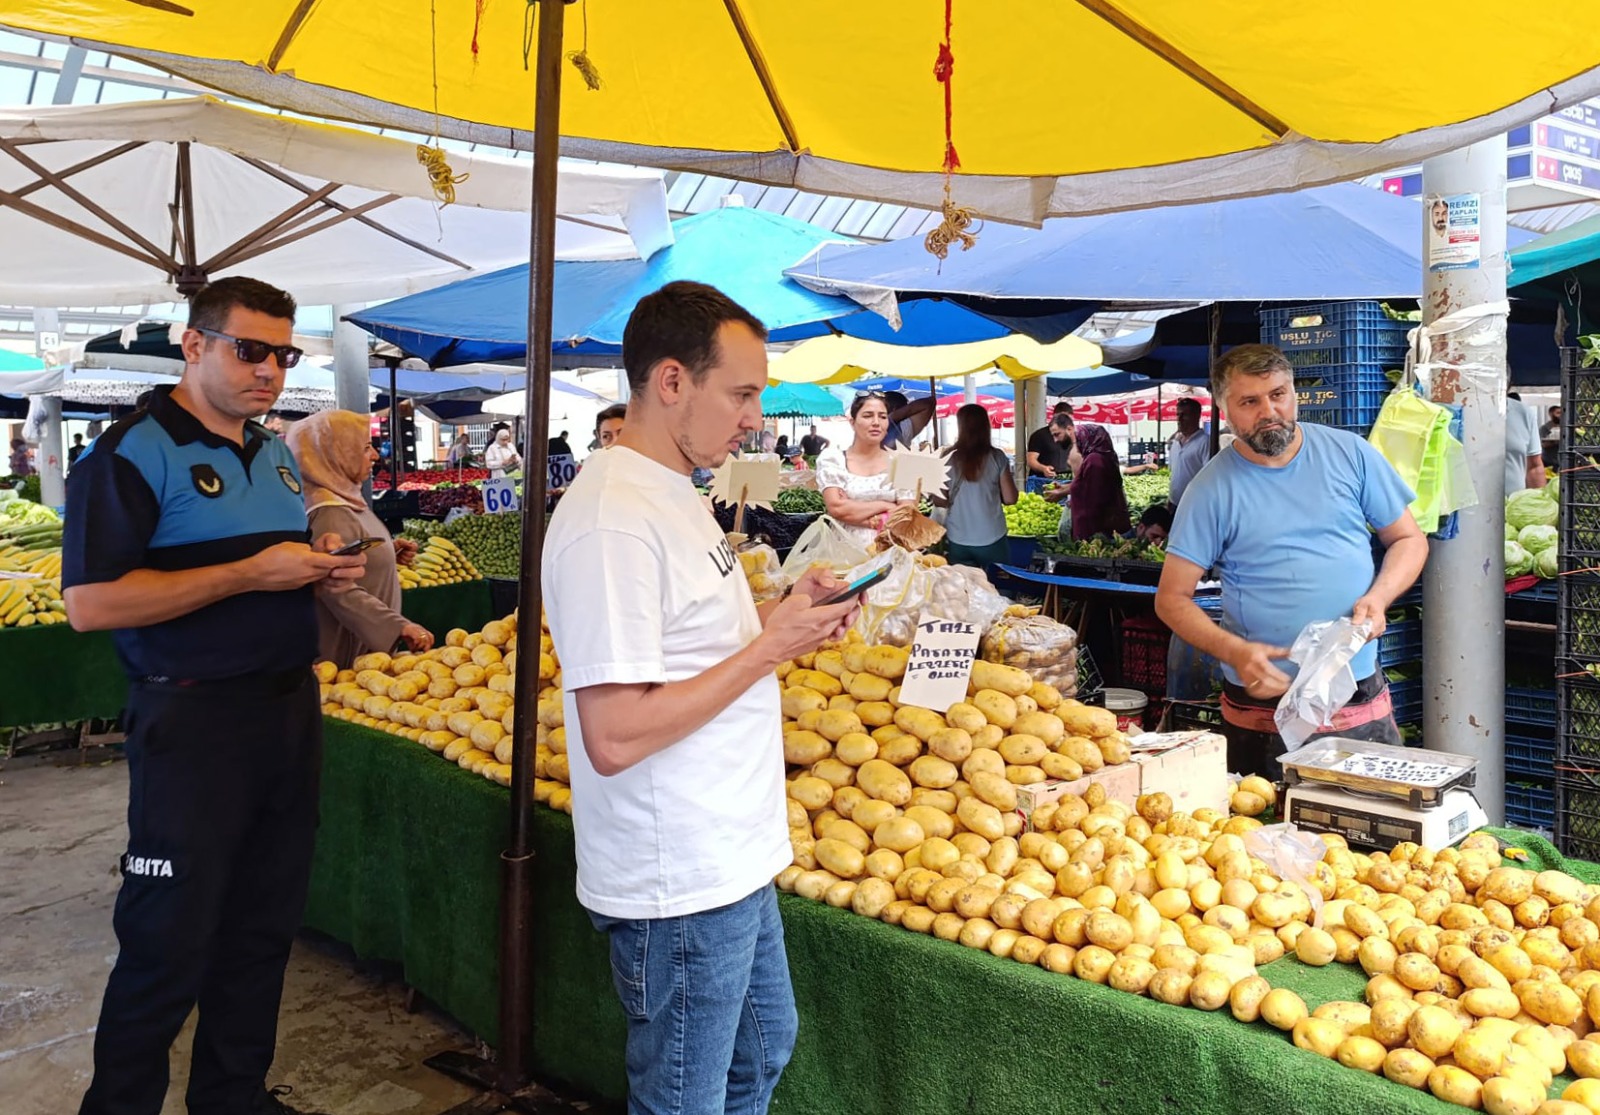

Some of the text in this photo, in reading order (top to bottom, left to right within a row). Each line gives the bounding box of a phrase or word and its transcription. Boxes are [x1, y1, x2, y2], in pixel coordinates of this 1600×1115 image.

[1563, 134, 1578, 150] WC
[1449, 199, 1478, 209] REMZİ
[1449, 208, 1478, 216] KAPLAN
[1280, 331, 1309, 341] USLU
[1295, 391, 1310, 400] LU
[549, 462, 576, 488] 80
[486, 487, 512, 512] 60
[126, 855, 173, 877] ABITA
